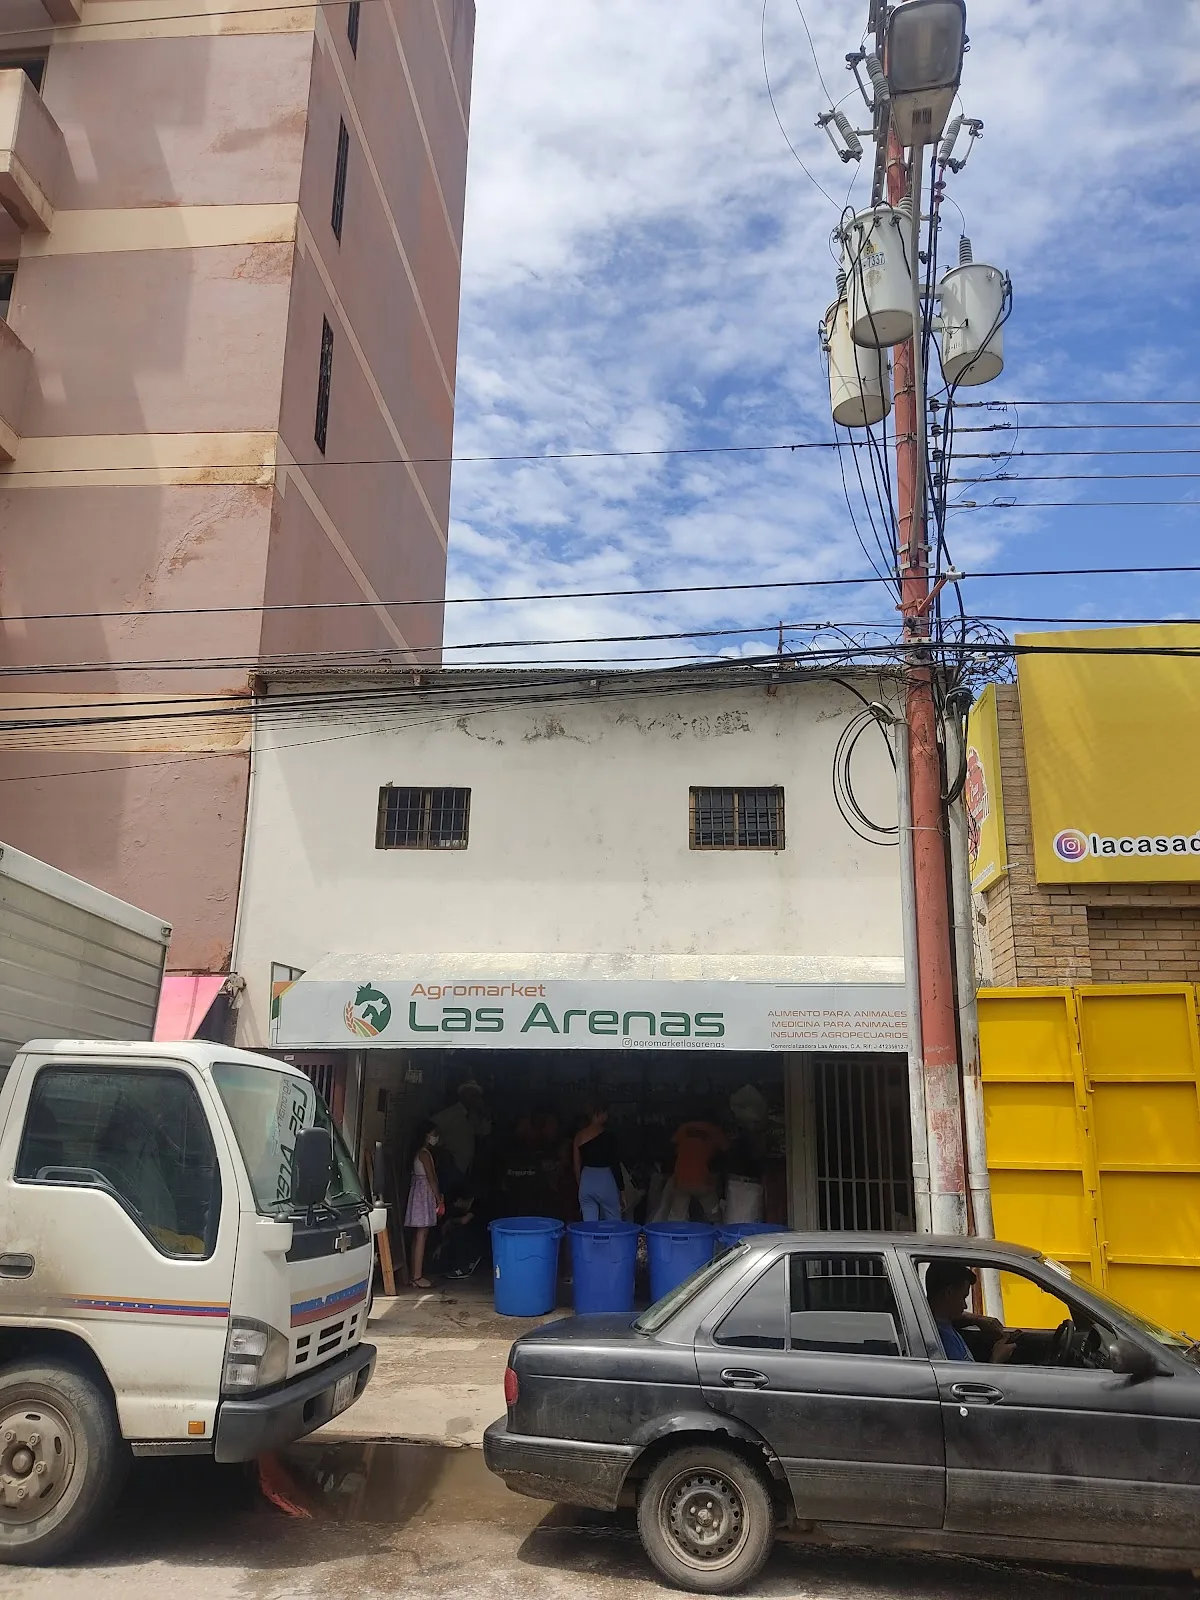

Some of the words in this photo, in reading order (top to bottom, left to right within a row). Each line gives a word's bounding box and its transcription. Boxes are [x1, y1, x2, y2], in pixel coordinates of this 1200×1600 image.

[410, 983, 546, 1000] Agromarket
[408, 1001, 504, 1032] Las
[520, 1002, 725, 1037] Arenas
[821, 1031, 908, 1039] AGROPECUARIOS
